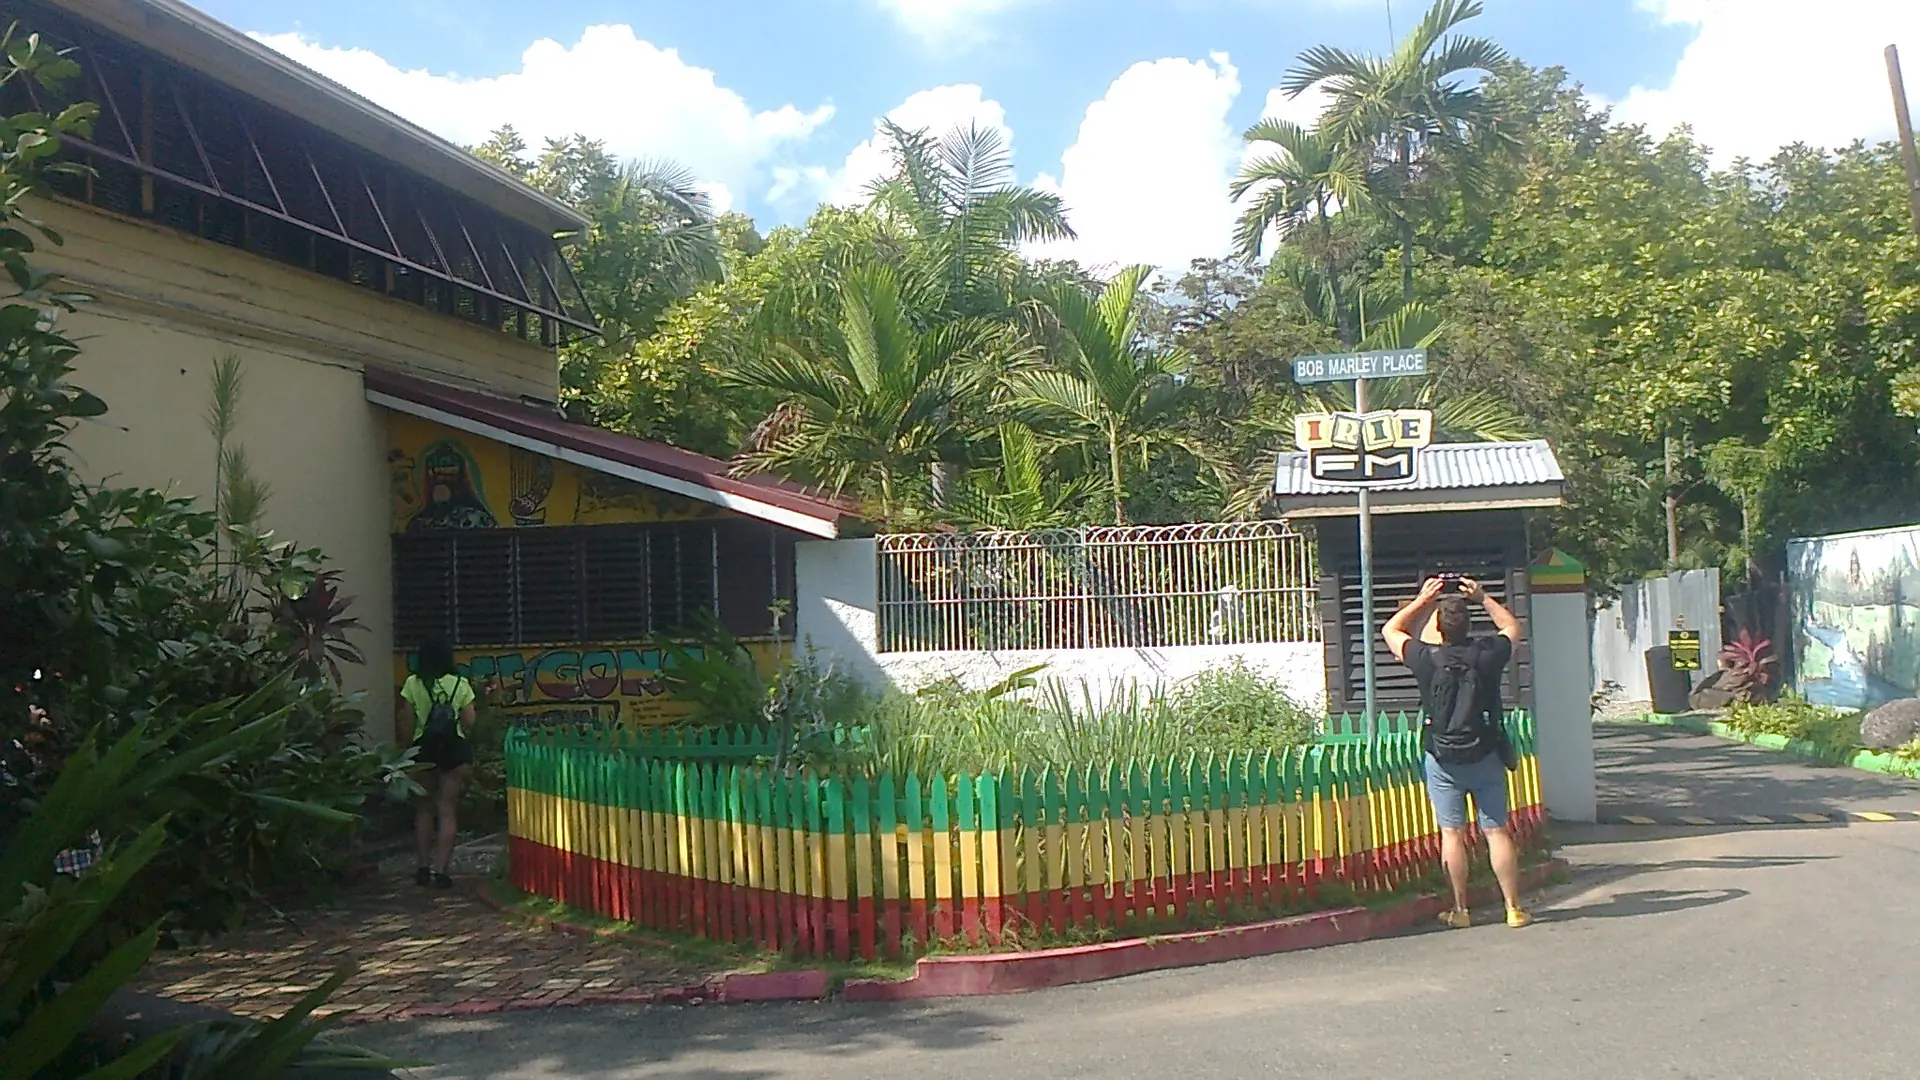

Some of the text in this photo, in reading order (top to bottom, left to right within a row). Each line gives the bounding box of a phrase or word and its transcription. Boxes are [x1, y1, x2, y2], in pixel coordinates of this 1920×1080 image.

[1297, 354, 1424, 377] BOB MARLEY PLACE
[1307, 418, 1421, 443] IRIE
[1315, 454, 1409, 477] FM
